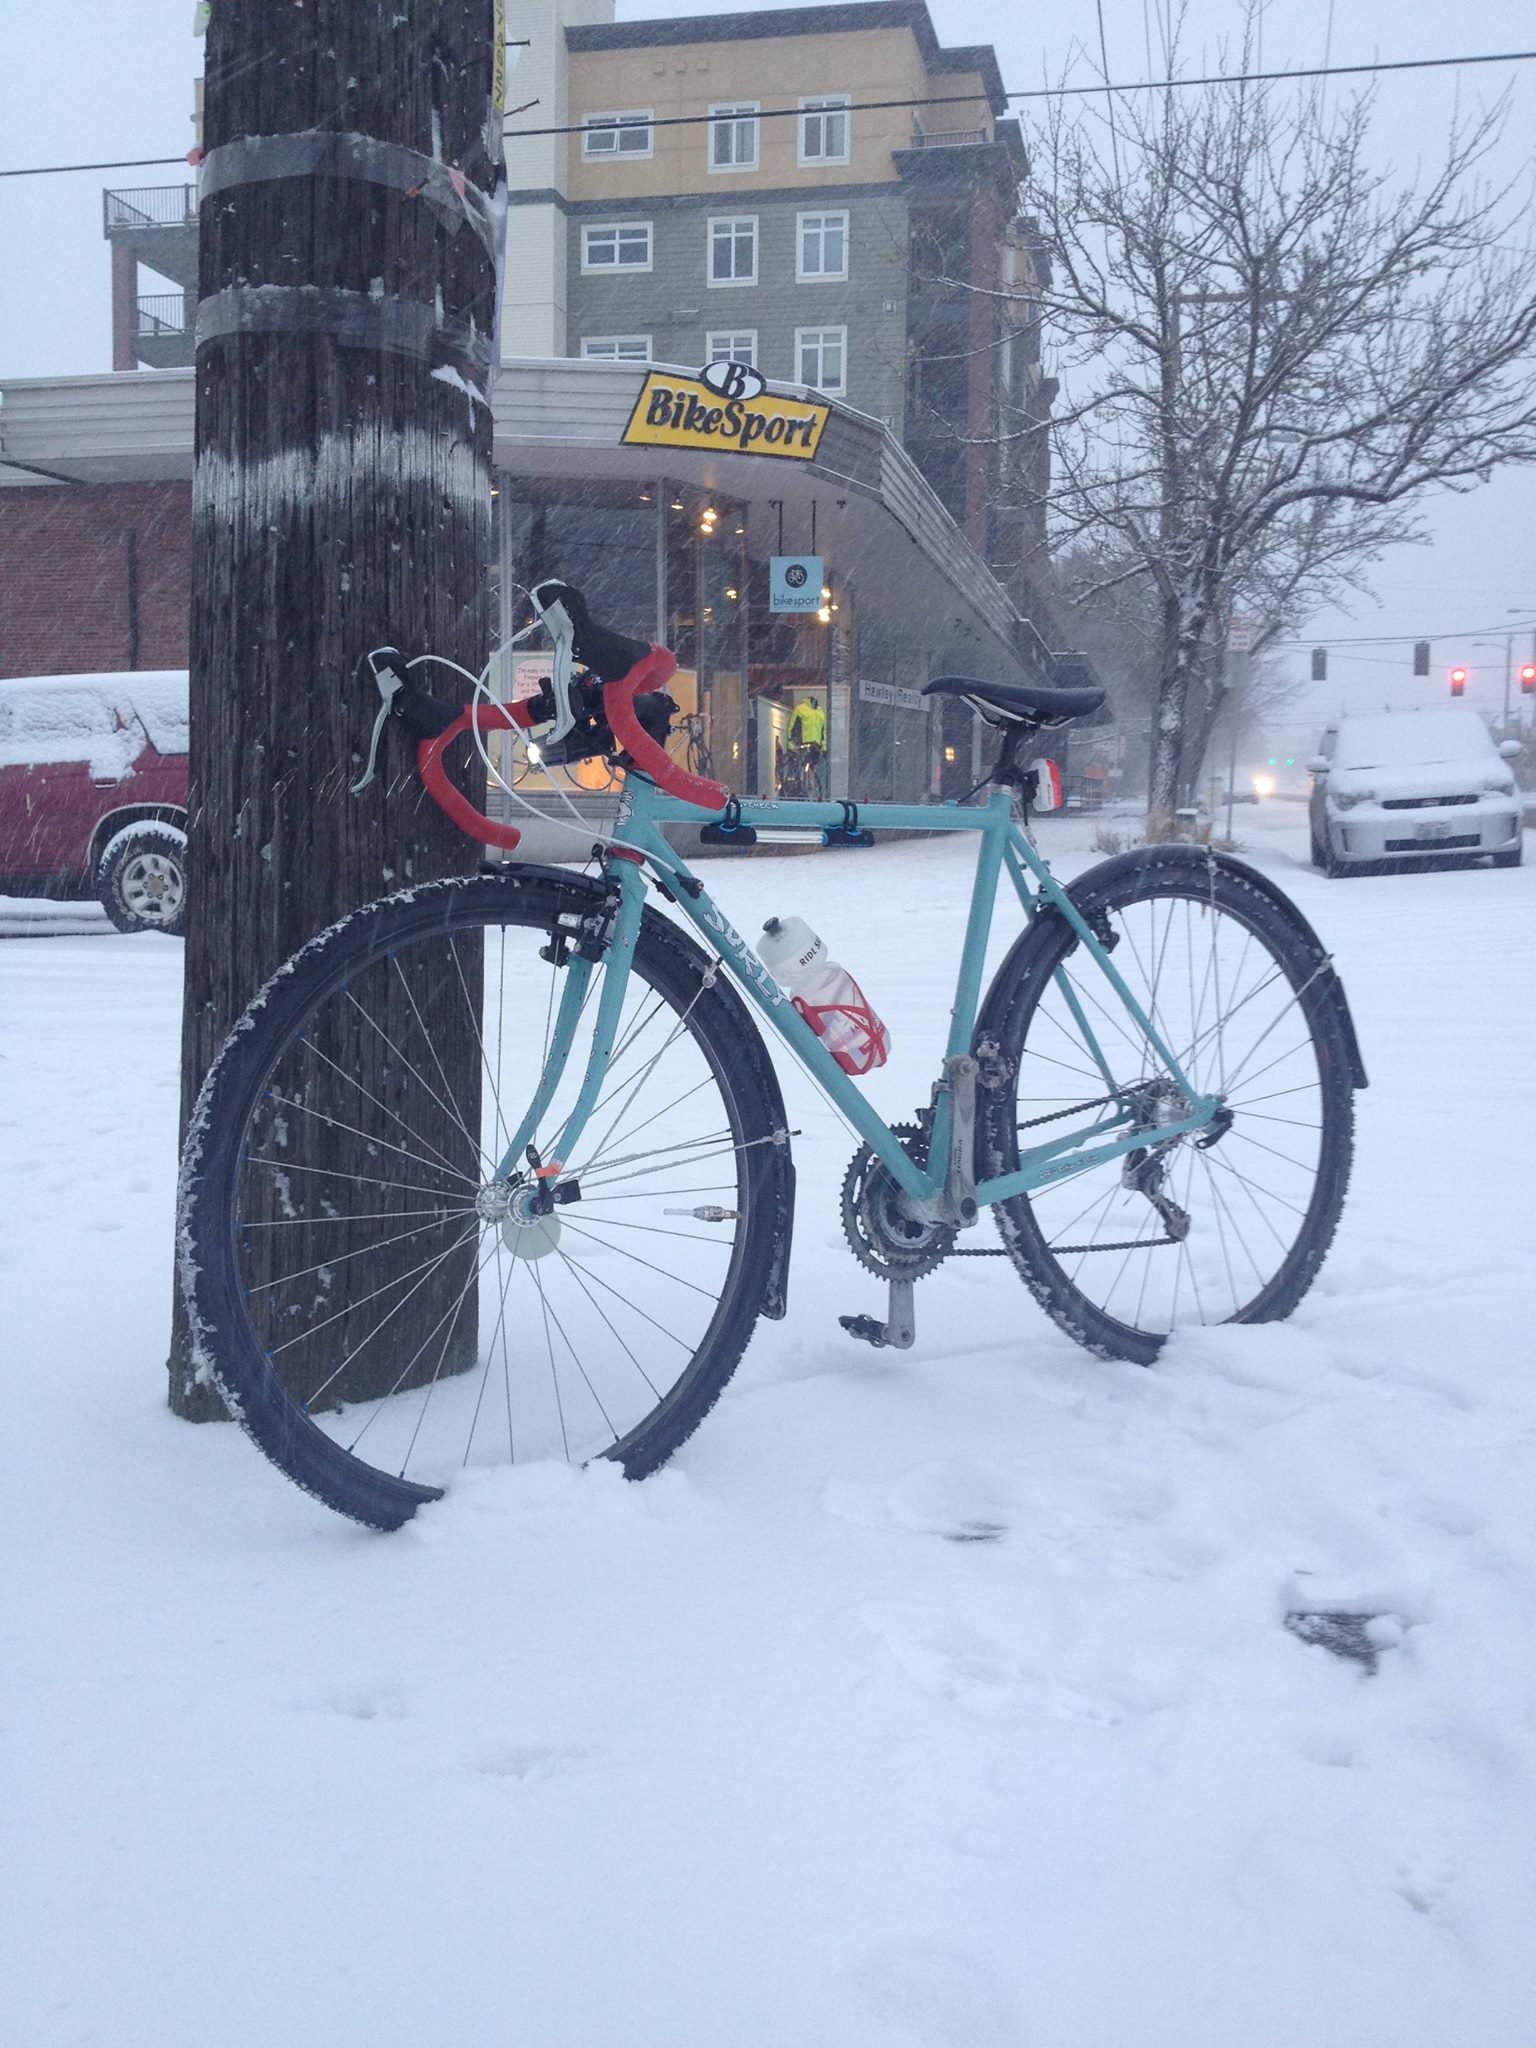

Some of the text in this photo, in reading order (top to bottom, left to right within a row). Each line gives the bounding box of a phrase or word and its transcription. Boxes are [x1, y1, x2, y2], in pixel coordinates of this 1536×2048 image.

[722, 363, 748, 399] B
[646, 388, 818, 448] BikeSport
[773, 593, 820, 608] bikesport
[702, 902, 791, 1007] SURLY
[799, 947, 817, 967] RIDE
